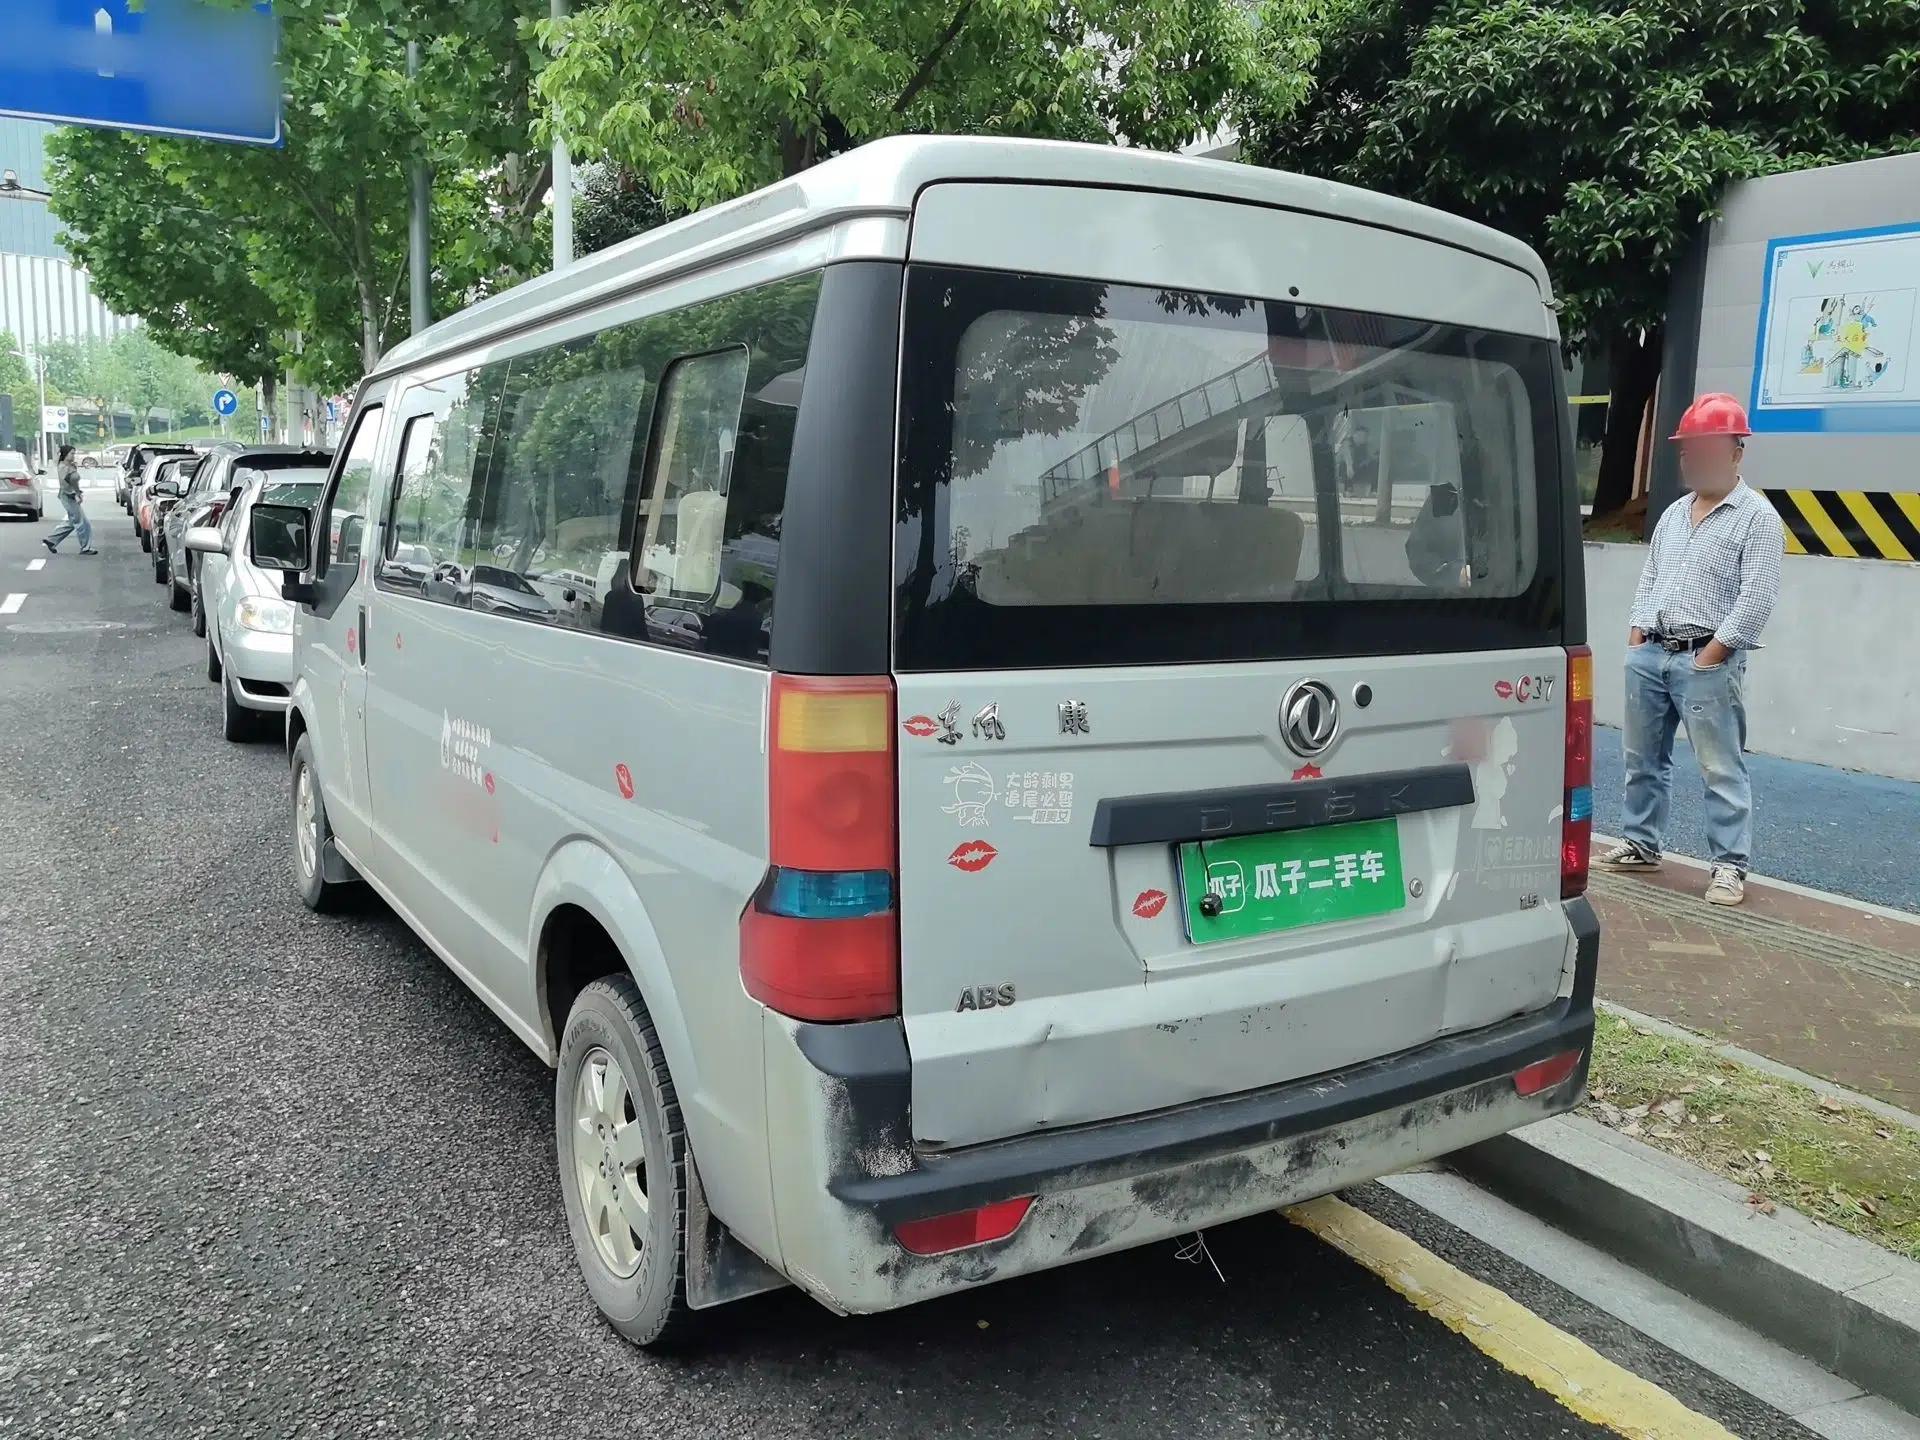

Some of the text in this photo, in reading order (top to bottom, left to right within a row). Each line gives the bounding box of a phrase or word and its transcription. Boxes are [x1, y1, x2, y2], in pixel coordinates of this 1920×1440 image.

[1516, 674, 1556, 702] C37
[1006, 772, 1075, 790] 大龄剩男
[1005, 790, 1074, 808] 追尾必娶
[1209, 874, 1242, 899] 瓜子
[1254, 850, 1386, 900] 瓜子二手车
[956, 981, 1017, 1013] ABS
